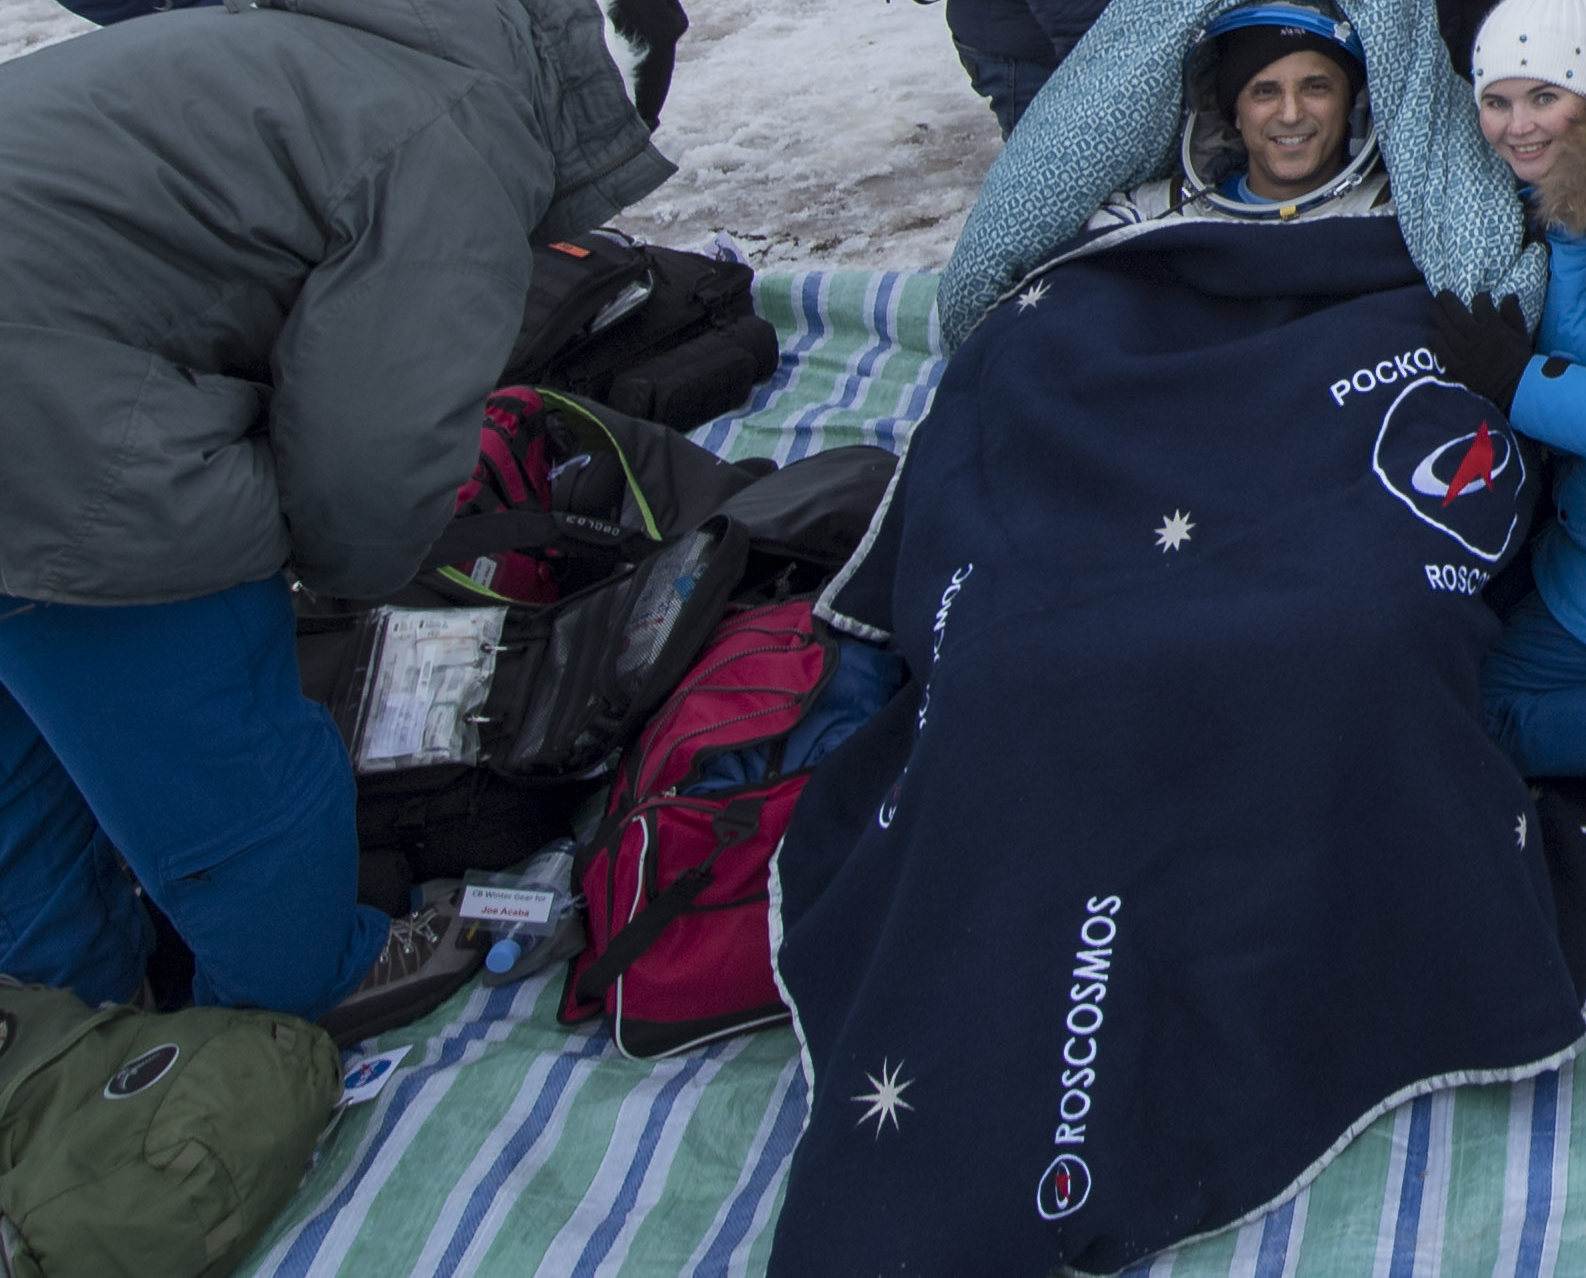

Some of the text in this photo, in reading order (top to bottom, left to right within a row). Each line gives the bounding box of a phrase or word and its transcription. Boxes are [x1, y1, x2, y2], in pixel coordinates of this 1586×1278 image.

[534, 893, 547, 902] for
[480, 905, 530, 917] Joe Acaba
[1055, 894, 1121, 1146] ROSCOSMOS
